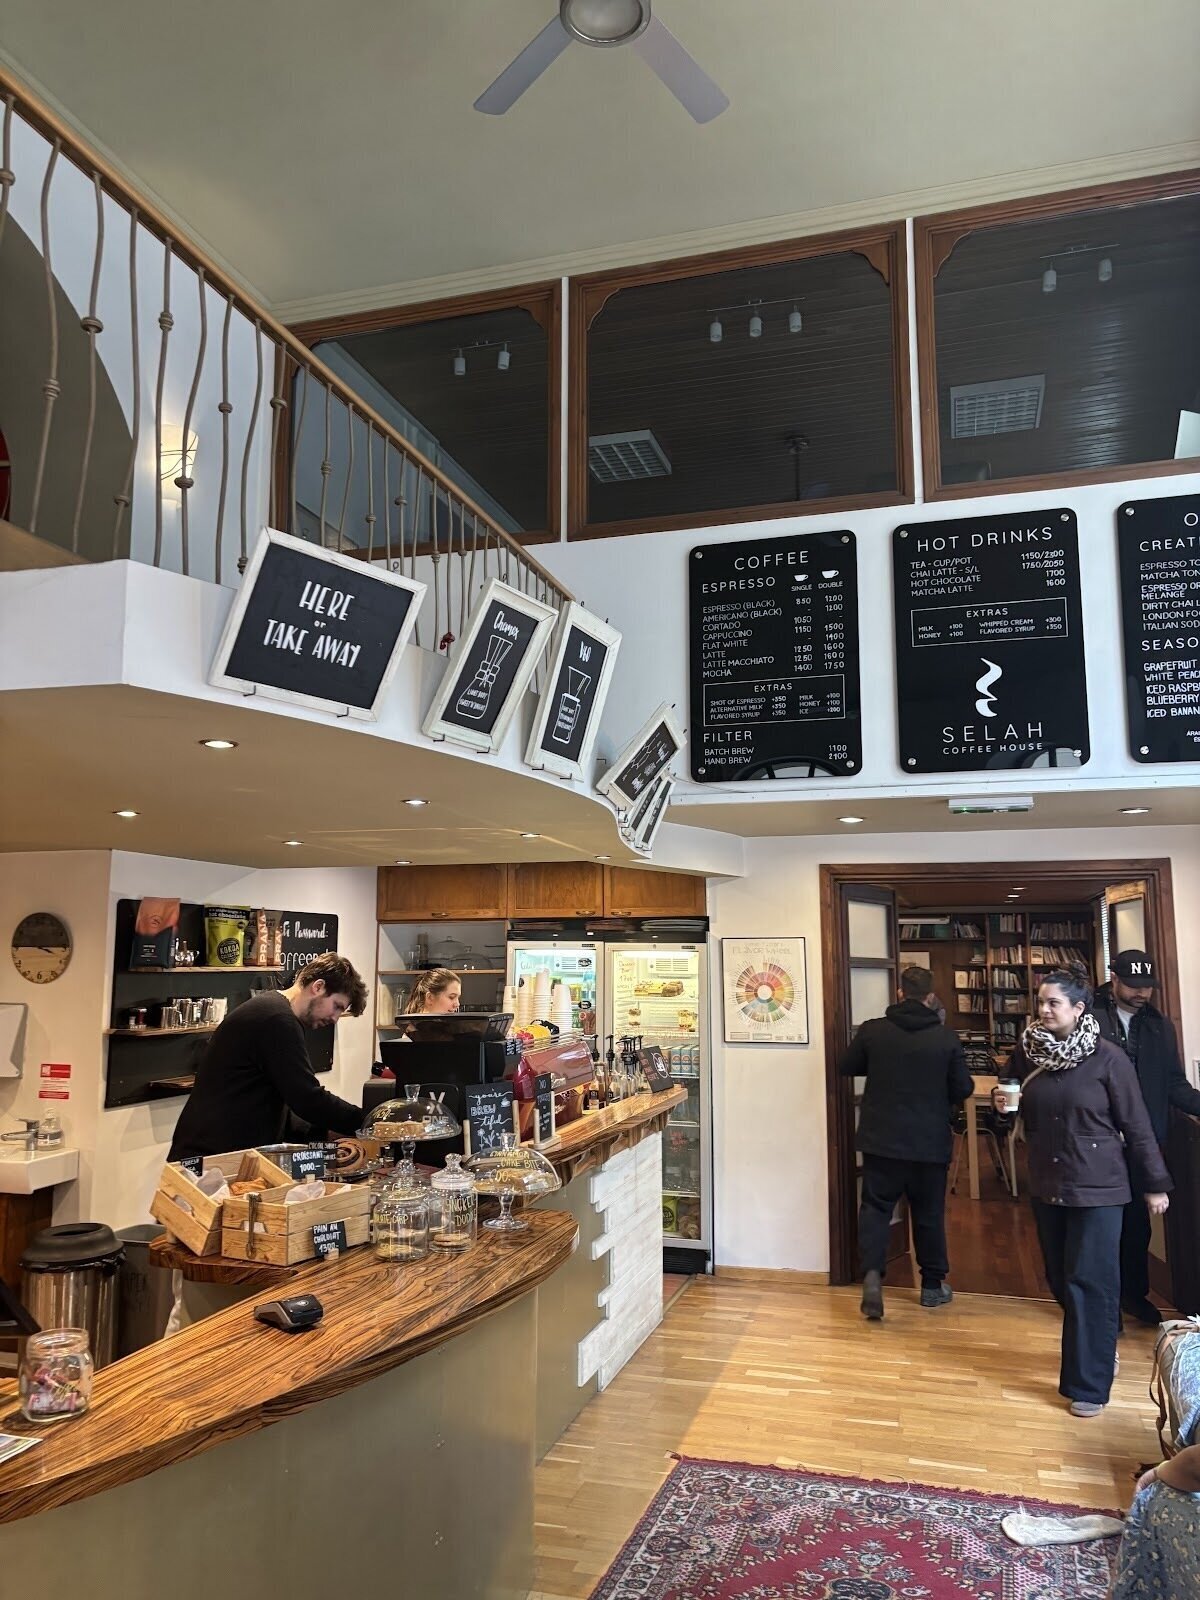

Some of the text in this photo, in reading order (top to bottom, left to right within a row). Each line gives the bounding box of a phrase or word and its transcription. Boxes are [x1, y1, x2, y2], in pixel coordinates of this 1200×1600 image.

[917, 527, 1053, 552] HOT DRINKS
[1140, 536, 1200, 552] CREAT
[734, 551, 809, 570] COFFEE
[910, 561, 927, 570] TEA
[933, 556, 973, 567] CUP/POT
[1140, 560, 1187, 571] ESPRESSO
[910, 569, 931, 578] CHAI
[932, 567, 957, 577] LATTE
[965, 566, 980, 575] S/L
[1141, 571, 1180, 581] MATCHA
[910, 569, 1065, 588] HOT CHOCOLATE 1700
[702, 577, 776, 593] ESPRESSO
[818, 581, 843, 589] DOUBLE
[911, 578, 1066, 597] MATCHA LATTE 1600
[1141, 583, 1187, 593] ESPRESSO
[299, 581, 355, 621] HERE
[1141, 591, 1185, 600] MELANGE
[702, 602, 741, 614] ESPRESSO
[742, 599, 775, 611] (BLACK)
[1142, 601, 1169, 611] DIRTY
[1171, 599, 1194, 608] CHAI
[702, 611, 749, 623] AMERICANO
[750, 607, 782, 619] (BLACK)
[966, 608, 1009, 618] EXTRAS
[1143, 609, 1200, 620] LONDON FO
[314, 620, 326, 628] or
[702, 621, 741, 632] CORTADO
[979, 620, 1009, 628] WHIPPED
[1010, 618, 1034, 626] CREAM
[1143, 621, 1179, 631] ITALIAN
[702, 629, 753, 641] CAPPUCCINO
[824, 623, 844, 631] 1500
[918, 632, 942, 640] HONEY
[979, 627, 1013, 635] FLAVORED
[263, 619, 362, 668] TAKE AWAY
[703, 641, 721, 650] FLAT
[722, 639, 748, 648] WHITE
[703, 642, 844, 660] LATTE 1250 1600
[703, 660, 726, 669] LATTE
[728, 656, 775, 667] MACCHIATO
[1143, 659, 1198, 672] GRAPEFRUIT
[703, 661, 845, 678] MOCHA 1400 1750
[1144, 670, 1200, 682] WHITE PEAC
[754, 683, 793, 693] EXTRAS
[1146, 682, 1200, 694] ICED RASPB
[737, 697, 766, 705] ESPRESSO
[1146, 693, 1199, 705] BLUEBERRY
[710, 704, 748, 714] ALTERNATIVE
[1146, 708, 1167, 718] ICED
[703, 730, 752, 743] FILTER
[942, 722, 1042, 743] SELAH
[704, 744, 847, 756] BATCH BREW 1100
[943, 742, 1043, 755] COFFEE HOUSE
[704, 752, 848, 765] HAND BREW 2100
[471, 1104, 496, 1116] BREW
[292, 1151, 323, 1162] CROISSANT
[313, 1224, 327, 1235] PAIN
